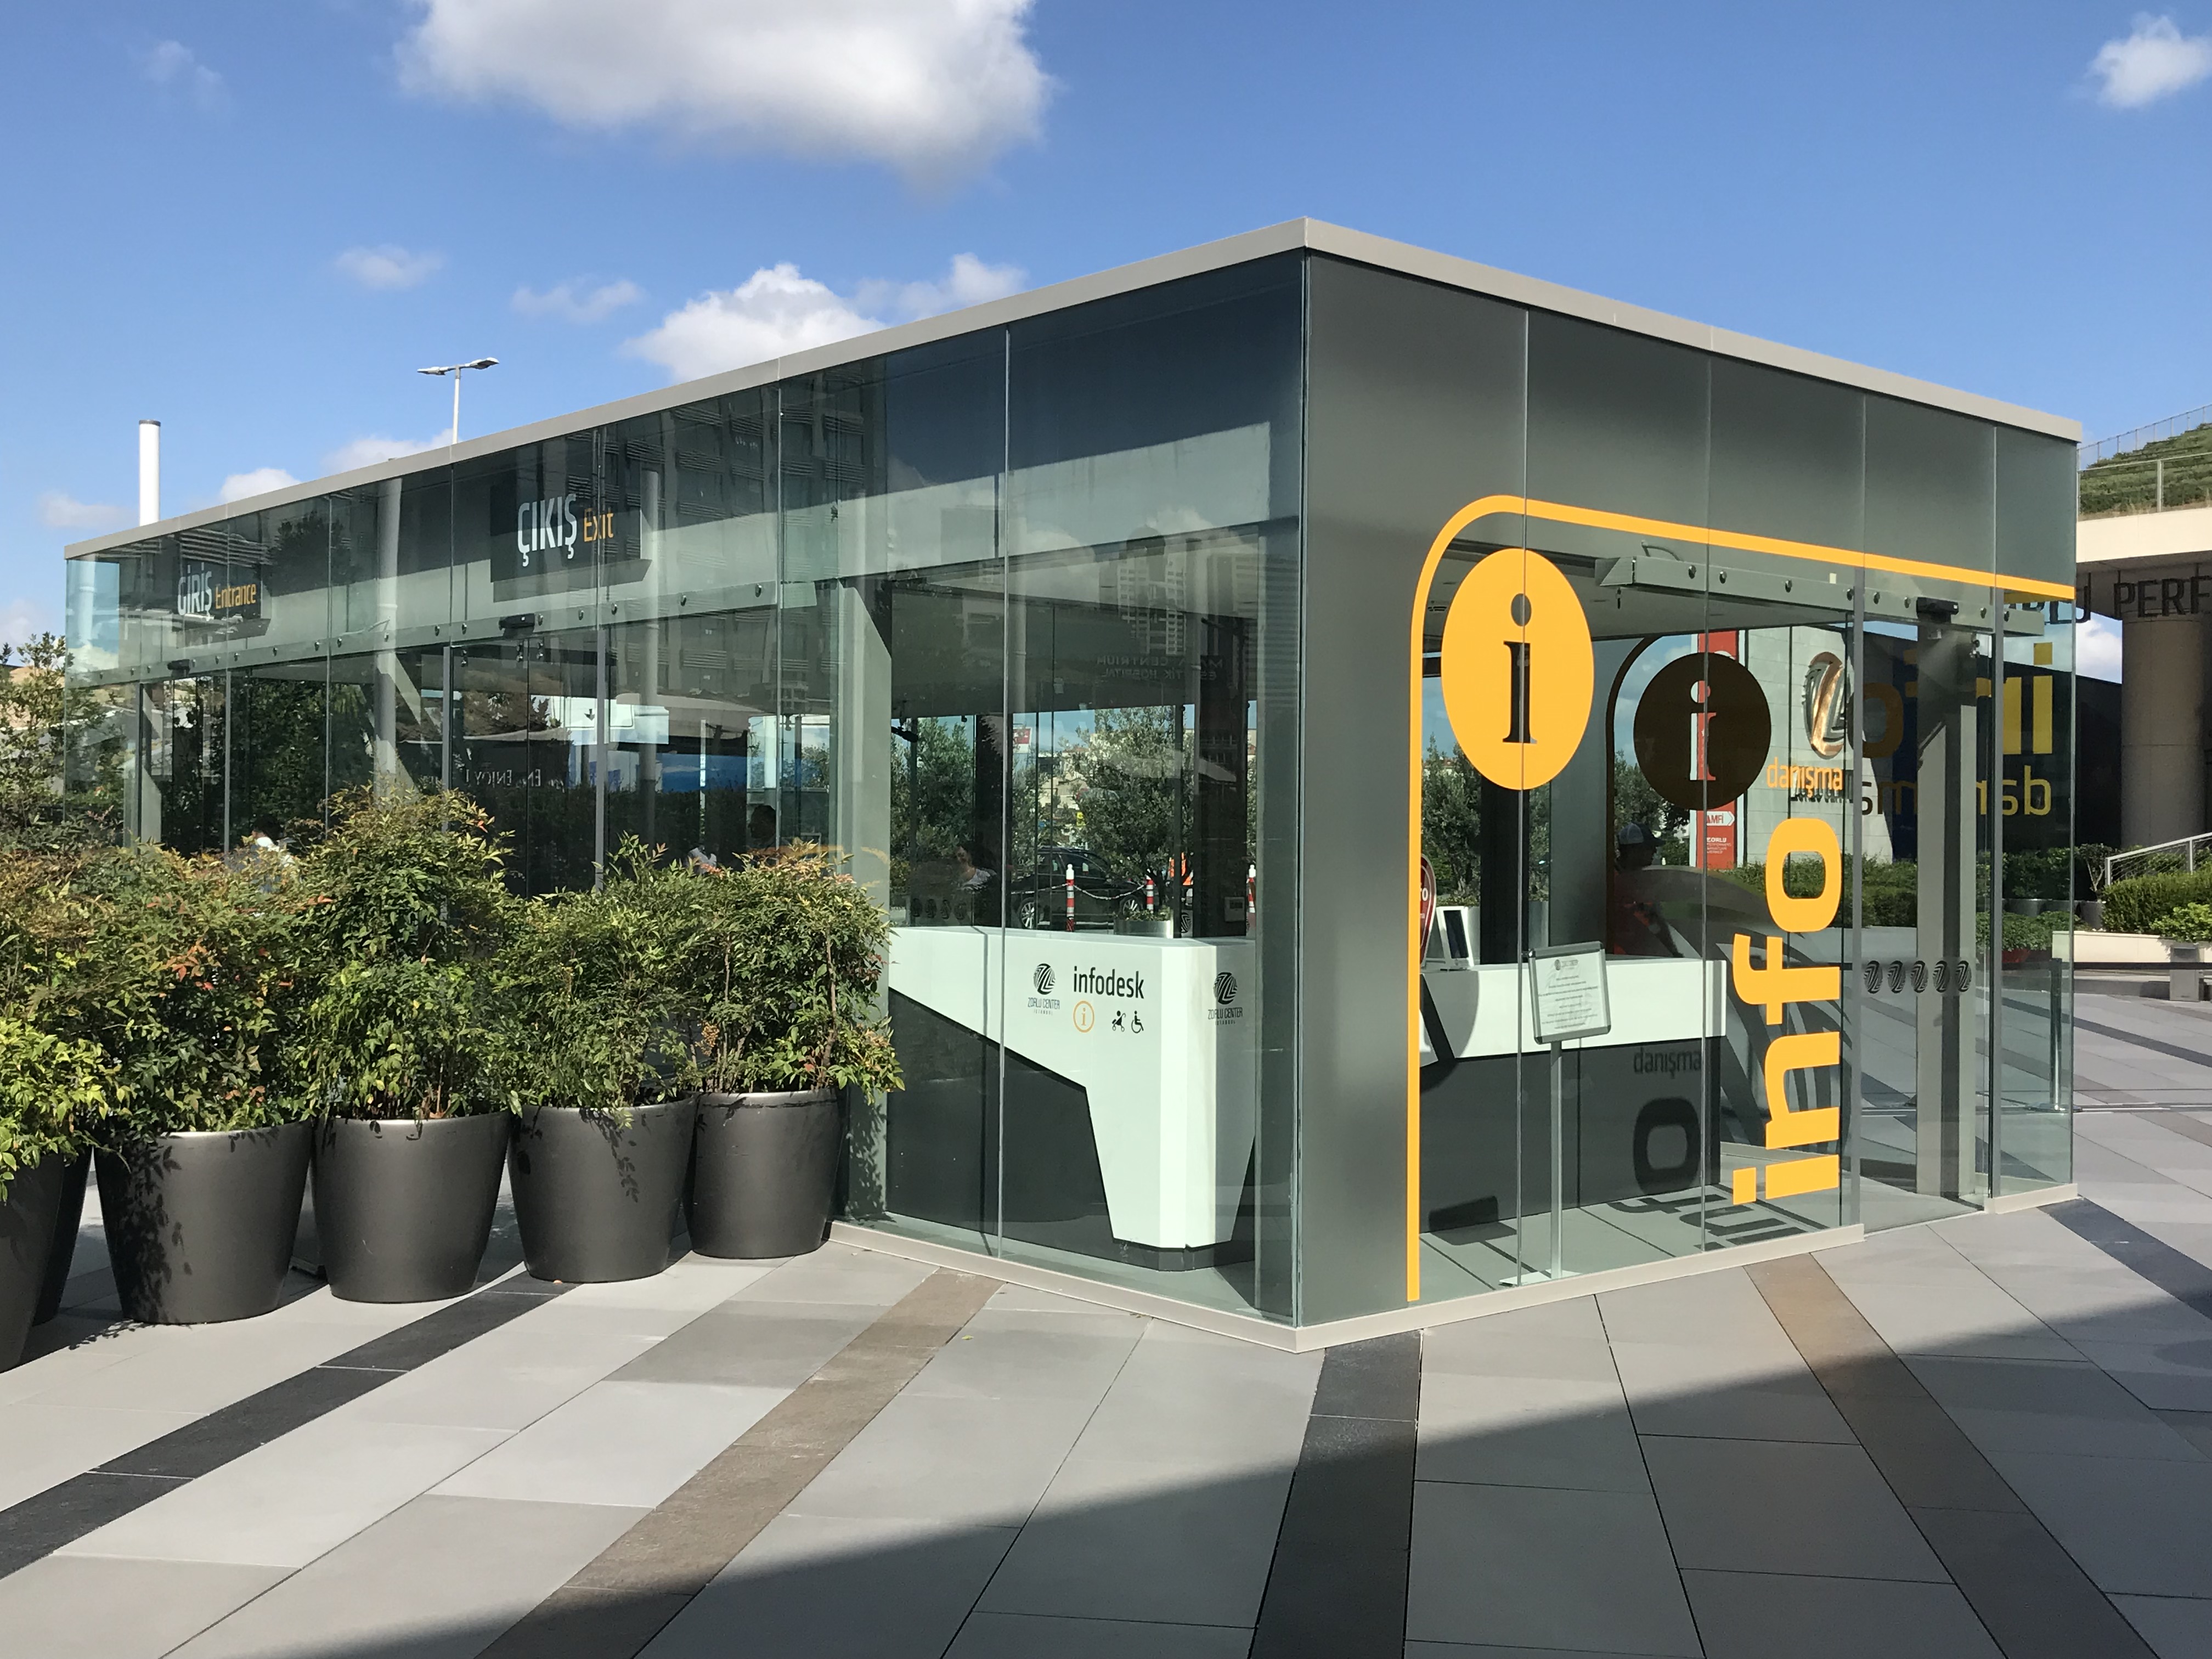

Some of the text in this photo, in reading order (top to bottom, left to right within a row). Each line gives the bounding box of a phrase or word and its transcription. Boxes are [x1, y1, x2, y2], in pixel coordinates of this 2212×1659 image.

[517, 494, 614, 567] ÇIKIŞ Exit
[178, 562, 256, 621] GİRİŞ Entrance
[1767, 756, 1843, 798] danışma
[1042, 998, 1060, 1009] CENTER
[1074, 966, 1144, 999] infodesk
[1224, 1007, 1243, 1019] CENTER
[1733, 817, 1842, 1206] info
